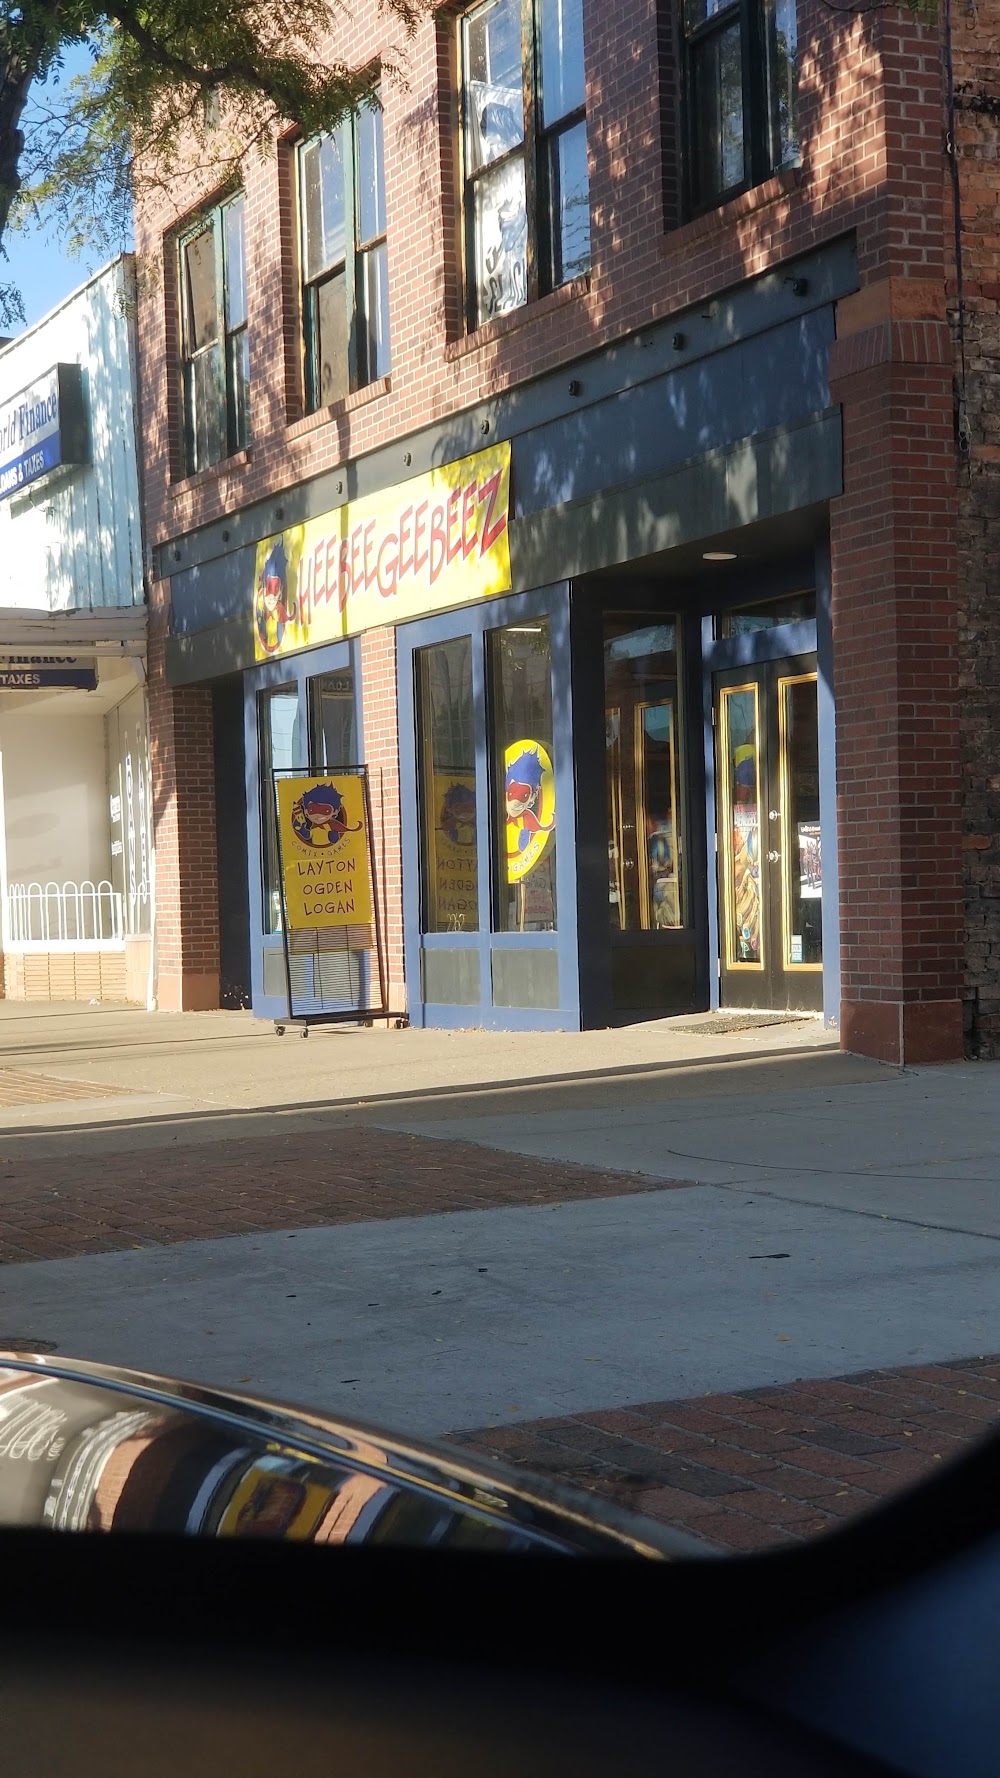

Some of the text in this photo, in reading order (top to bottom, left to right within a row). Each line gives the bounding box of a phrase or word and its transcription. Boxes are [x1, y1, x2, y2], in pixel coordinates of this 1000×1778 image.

[19, 392, 58, 440] Finance
[0, 449, 45, 492] OANS & TAXES
[298, 467, 507, 626] HEEBEEGEEBEEZ
[0, 673, 40, 685] TAXES
[291, 837, 351, 858] COMIX GAMES
[512, 841, 540, 872] GAMES
[297, 857, 356, 876] LAYTON
[302, 879, 353, 895] OGDEN
[303, 898, 355, 916] LOGAN
